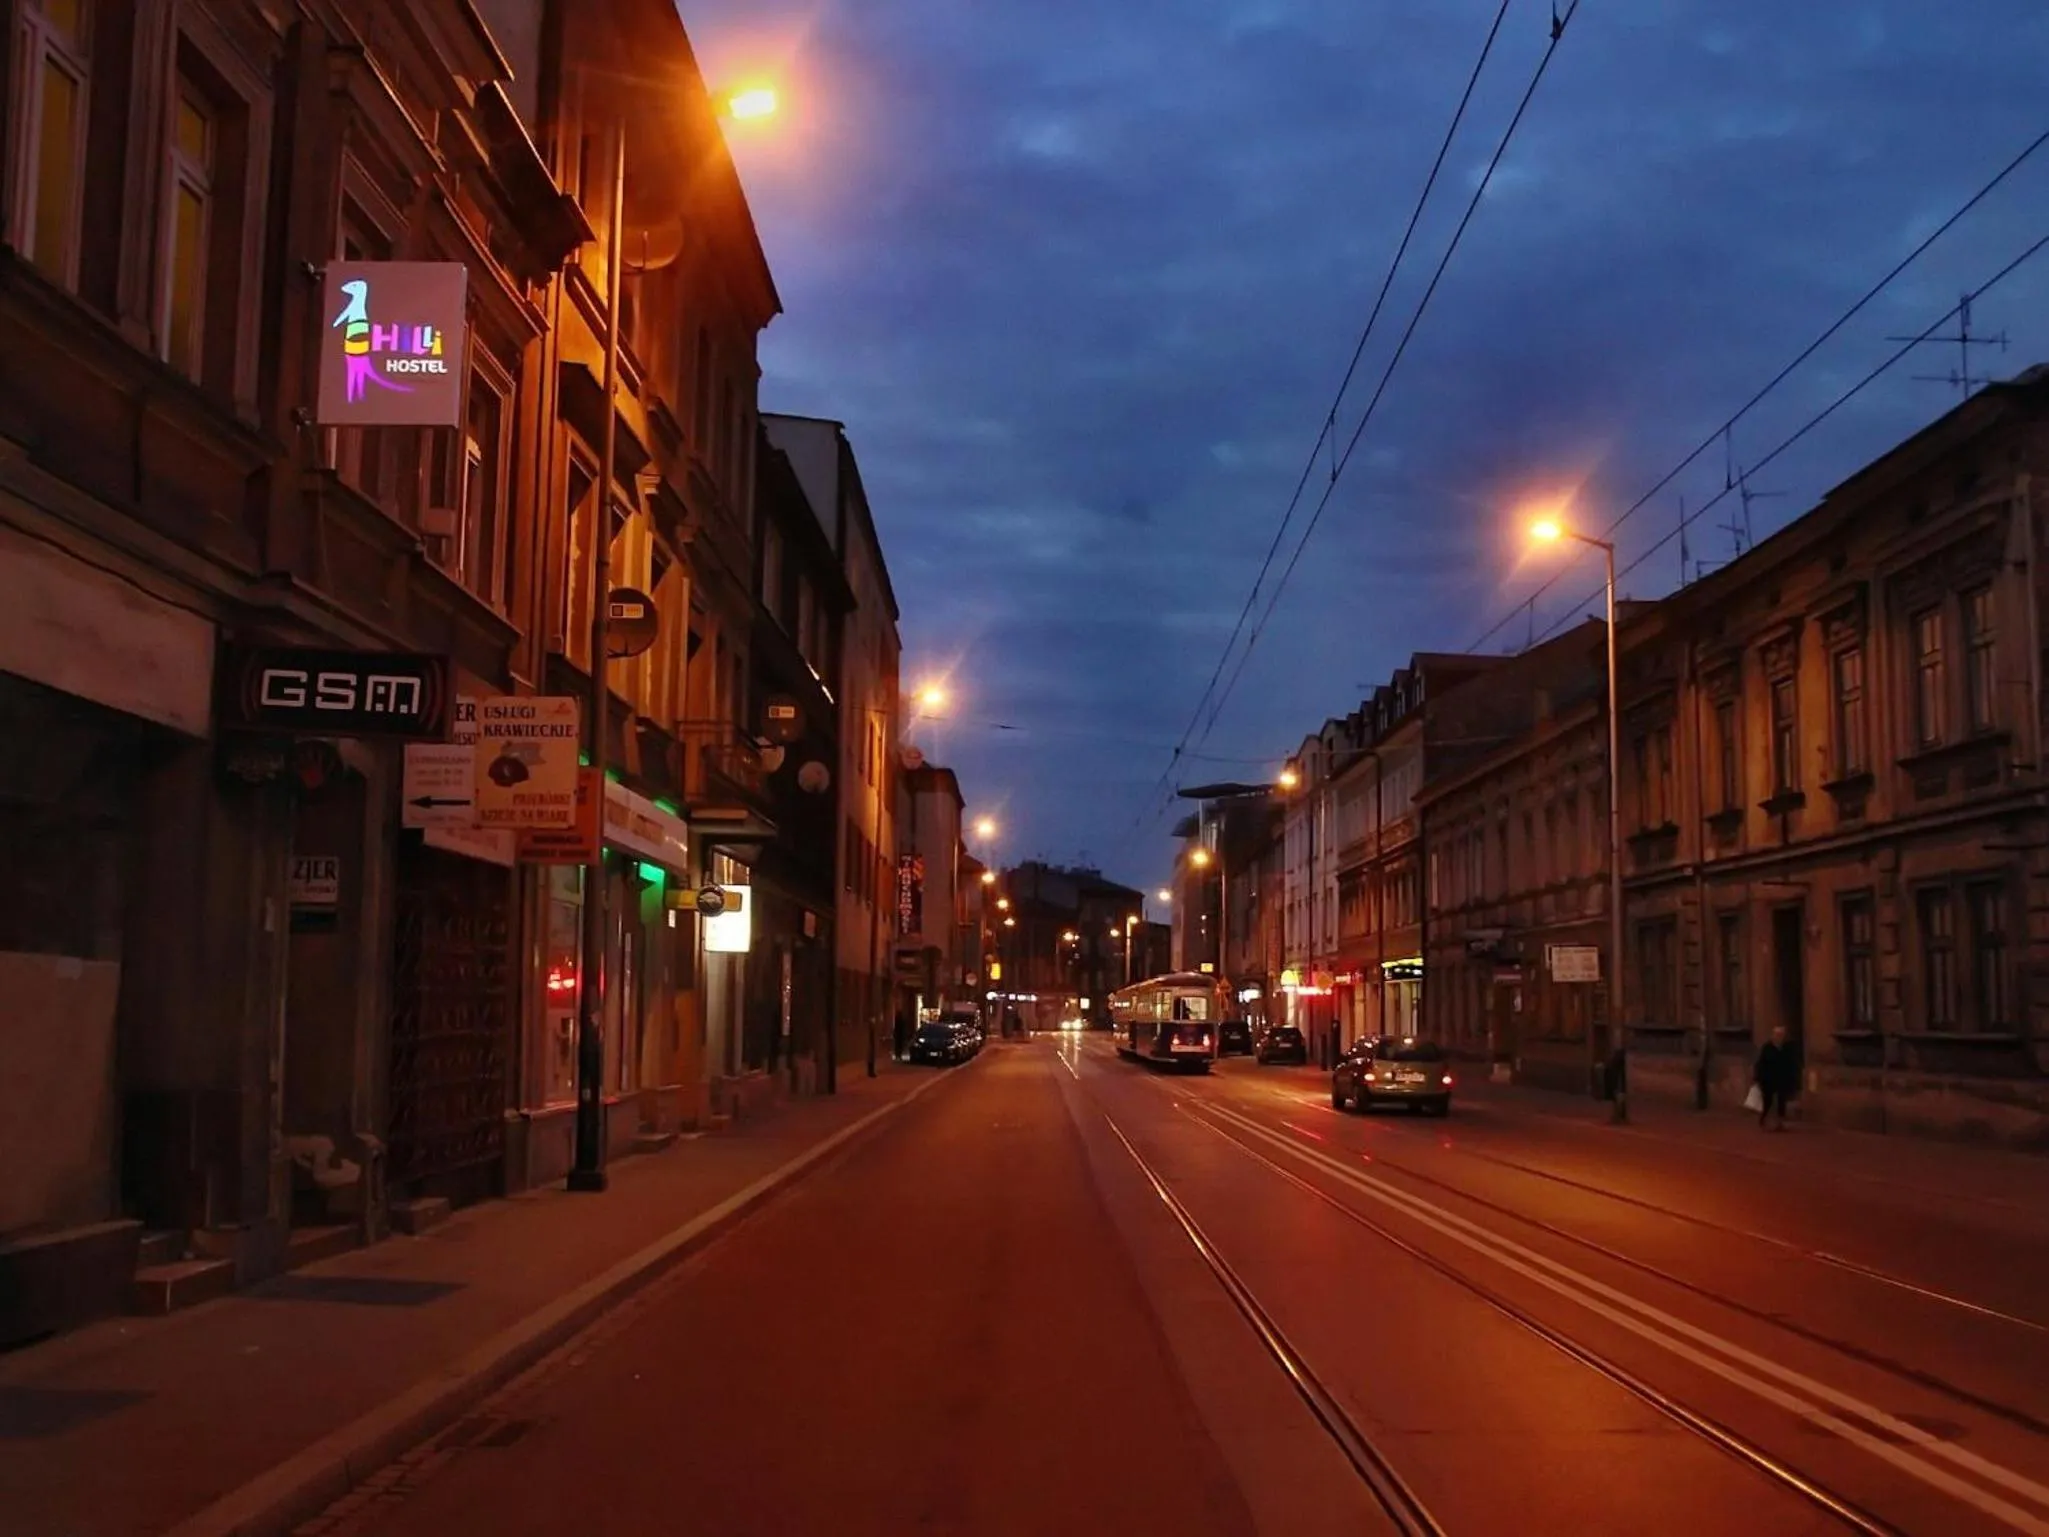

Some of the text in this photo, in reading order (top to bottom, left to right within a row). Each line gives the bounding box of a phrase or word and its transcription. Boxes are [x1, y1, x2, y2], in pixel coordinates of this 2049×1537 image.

[385, 359, 448, 374] HOSTEL
[261, 669, 421, 714] GSM
[483, 724, 574, 738] KRAWIECKIE
